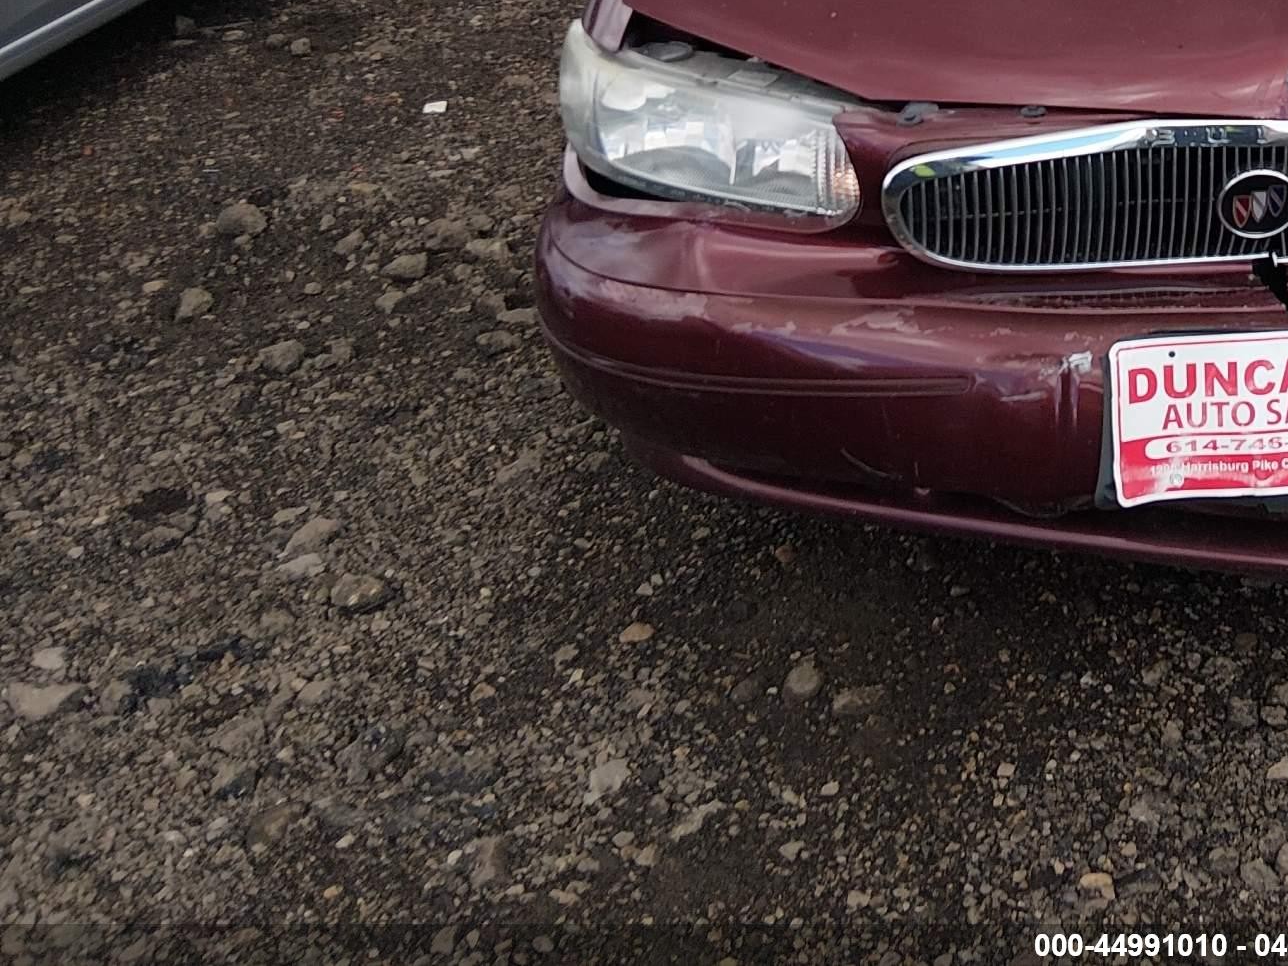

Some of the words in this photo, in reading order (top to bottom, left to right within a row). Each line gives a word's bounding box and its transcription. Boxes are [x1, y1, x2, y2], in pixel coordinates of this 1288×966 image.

[1162, 401, 1256, 431] AUTO
[1182, 460, 1249, 475] Harrisburg
[1252, 459, 1278, 472] Pike
